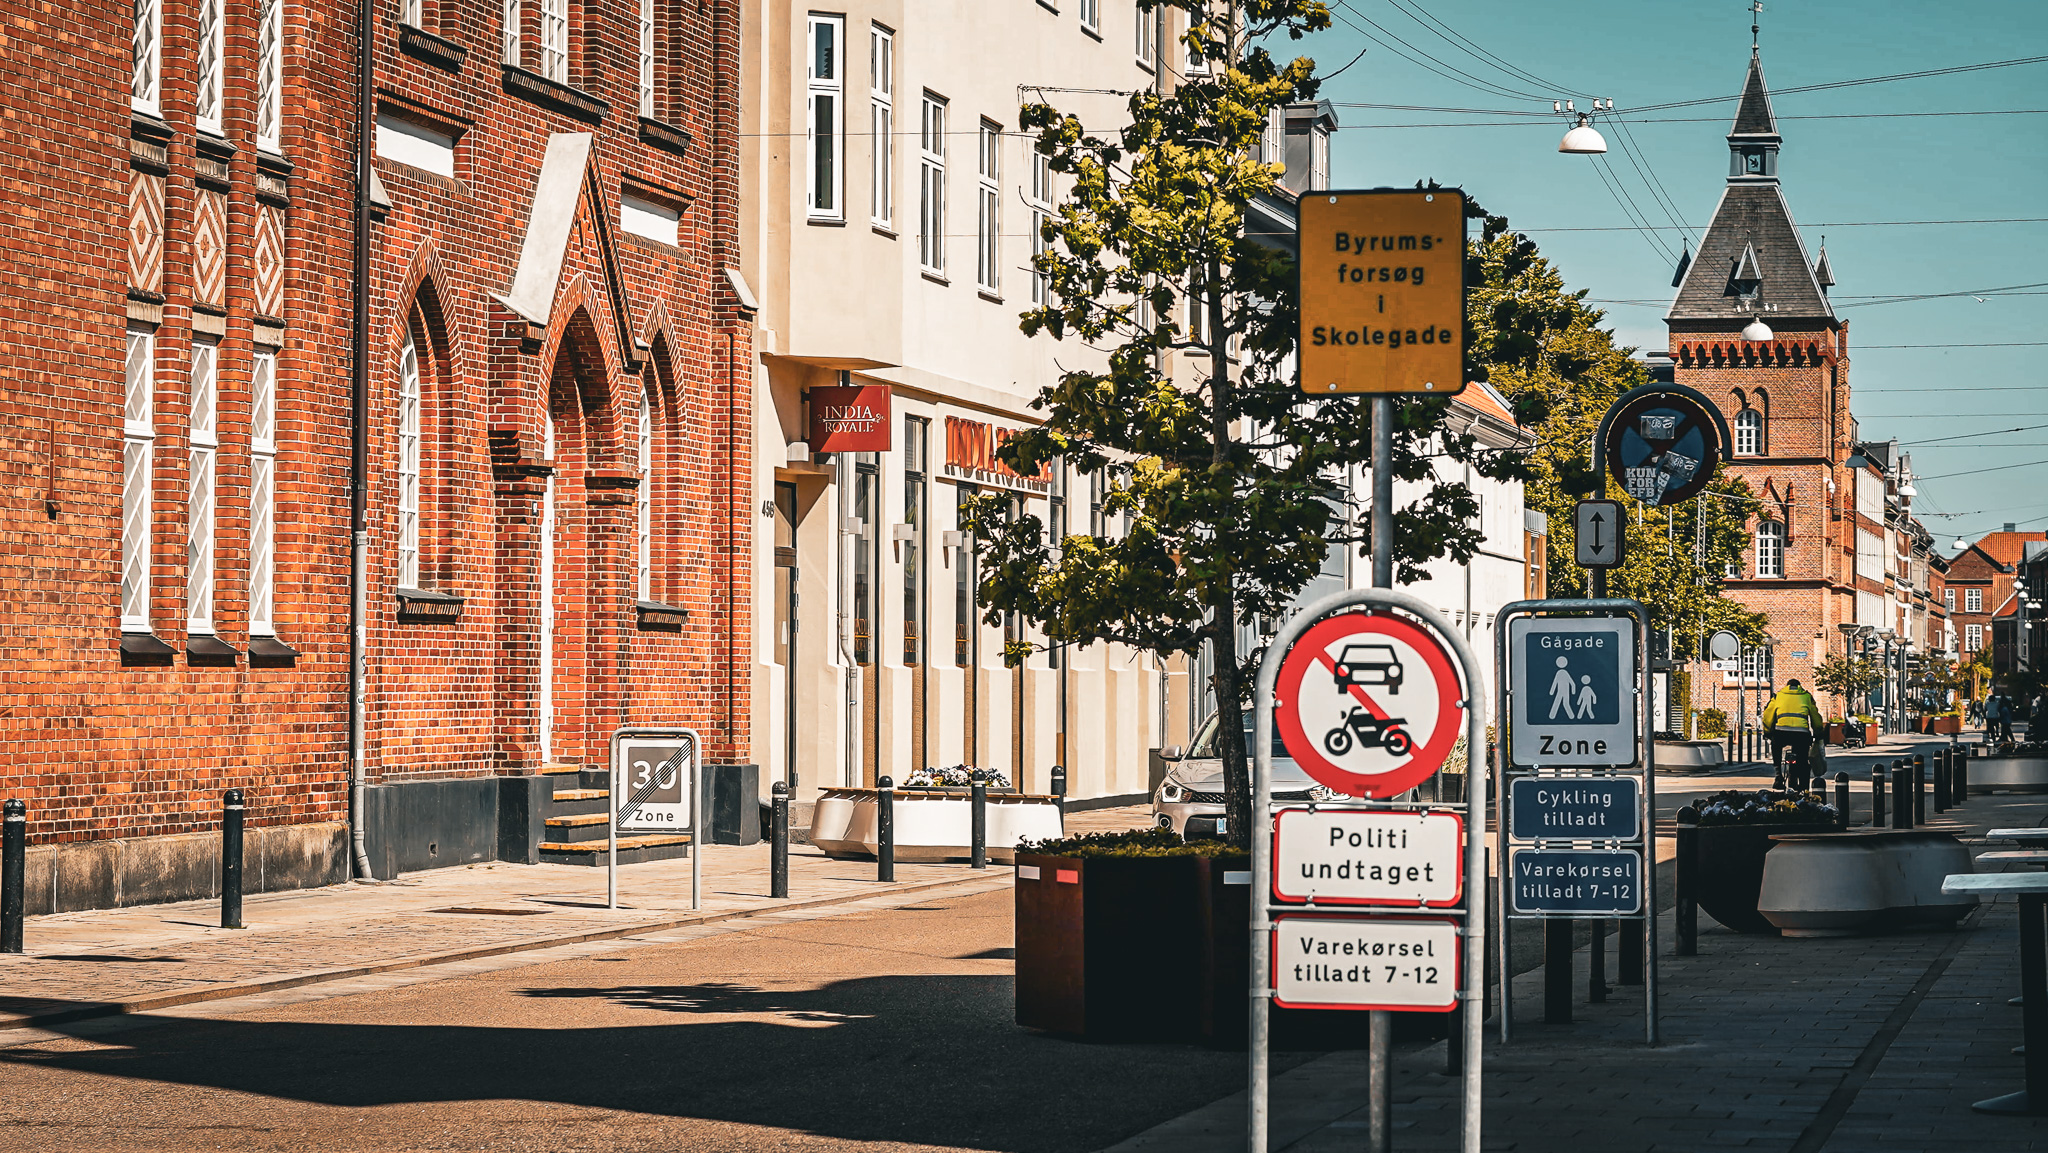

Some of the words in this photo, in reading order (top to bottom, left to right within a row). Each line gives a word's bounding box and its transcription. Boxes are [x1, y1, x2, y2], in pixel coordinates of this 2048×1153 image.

[1335, 232, 1443, 255] Byrums-
[1338, 264, 1424, 285] forsøg
[1378, 294, 1384, 313] i
[1312, 325, 1452, 348] Skolegade
[825, 405, 873, 419] INDIA
[825, 422, 875, 433] ROYALE
[945, 415, 995, 473] INDIA
[1626, 468, 1656, 478] KUN
[1628, 478, 1655, 488] FOR
[1628, 488, 1655, 498] EFB
[1541, 636, 1604, 650] Gågade
[1540, 735, 1607, 755] Zone
[632, 761, 677, 790] 30
[1537, 790, 1612, 808] Cykling
[635, 809, 674, 822] Zone
[1544, 812, 1605, 826] tilladt
[1330, 827, 1407, 849] Politi
[1301, 860, 1434, 885] undtaget
[1521, 862, 1631, 878] Varekørsel
[1522, 884, 1582, 898] tilladt
[1590, 885, 1630, 899] 7-12
[1300, 937, 1435, 957] Varekørsel
[1294, 964, 1371, 983] tilladt
[1385, 966, 1438, 984] 7-12
